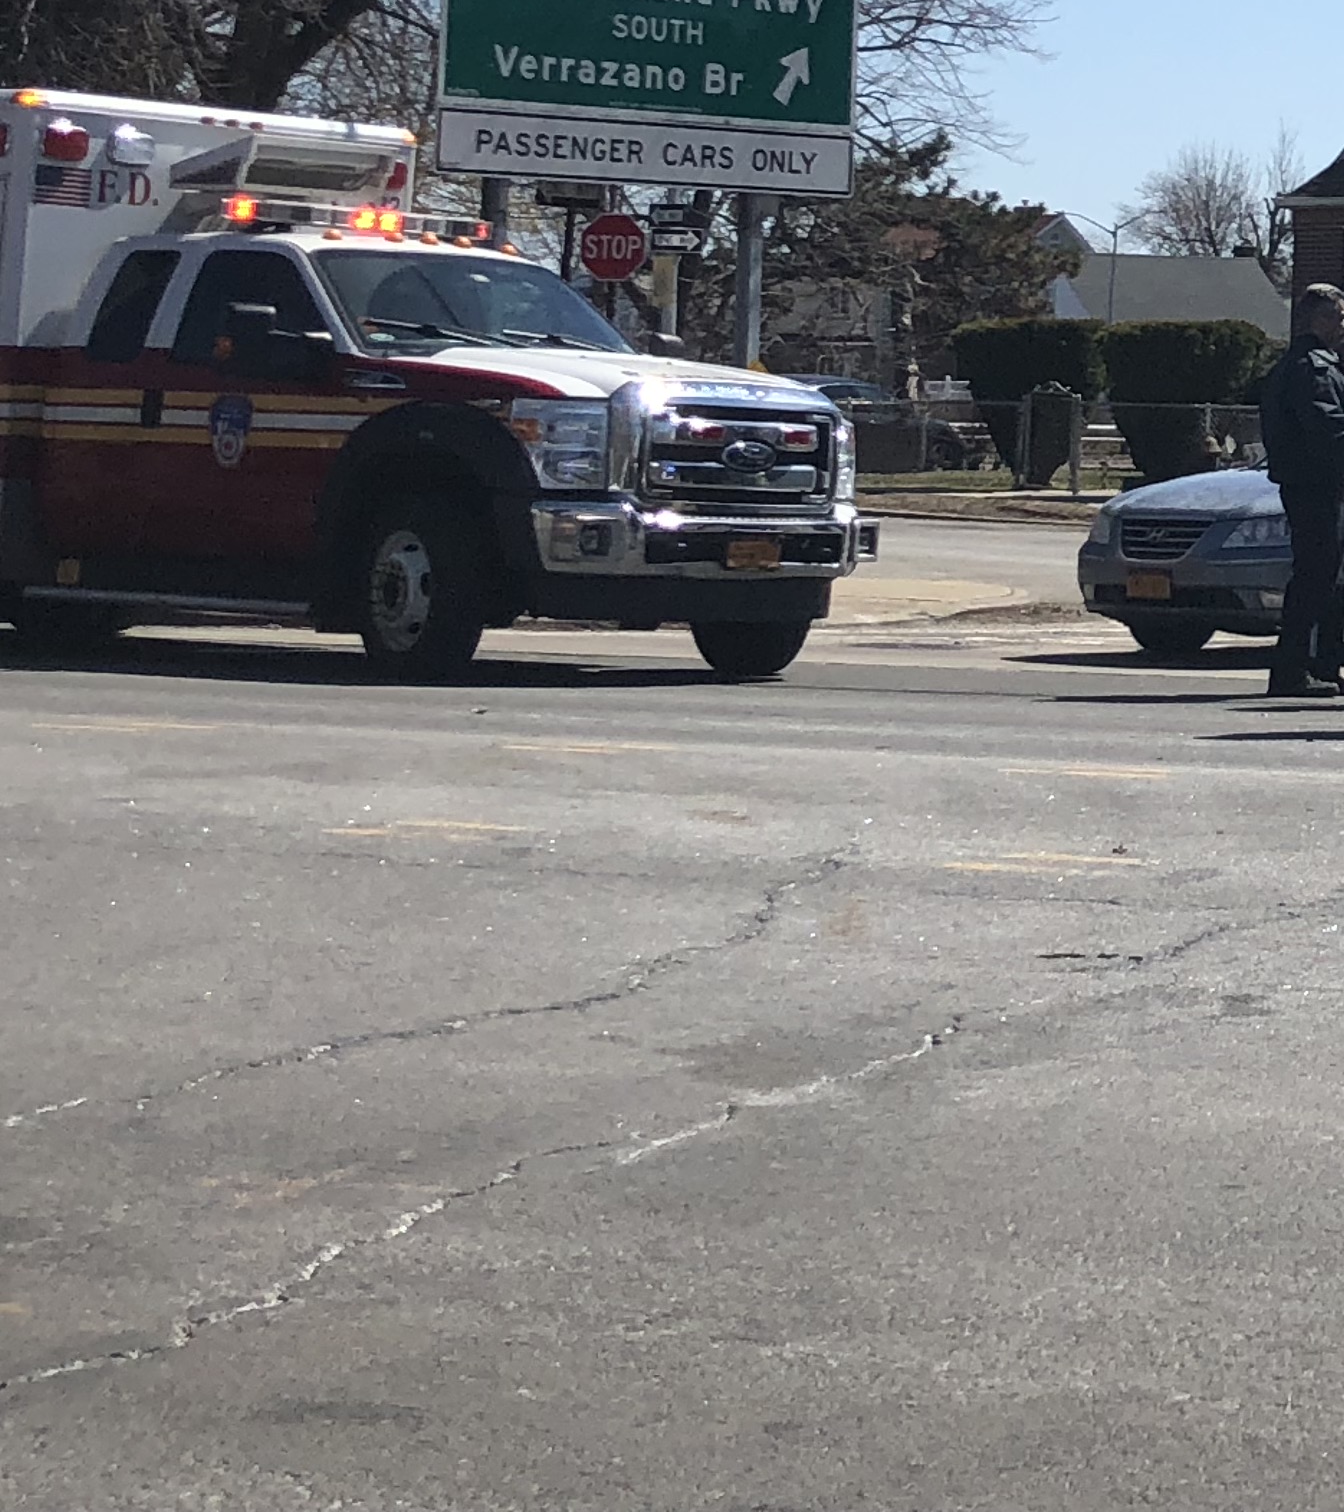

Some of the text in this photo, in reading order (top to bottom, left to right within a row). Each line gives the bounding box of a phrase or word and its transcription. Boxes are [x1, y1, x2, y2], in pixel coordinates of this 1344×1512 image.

[611, 13, 704, 45] SOUTH
[493, 43, 744, 96] Verrazano Br
[474, 128, 819, 175] PASSENGER CARS ONLY
[584, 234, 642, 260] STOP
